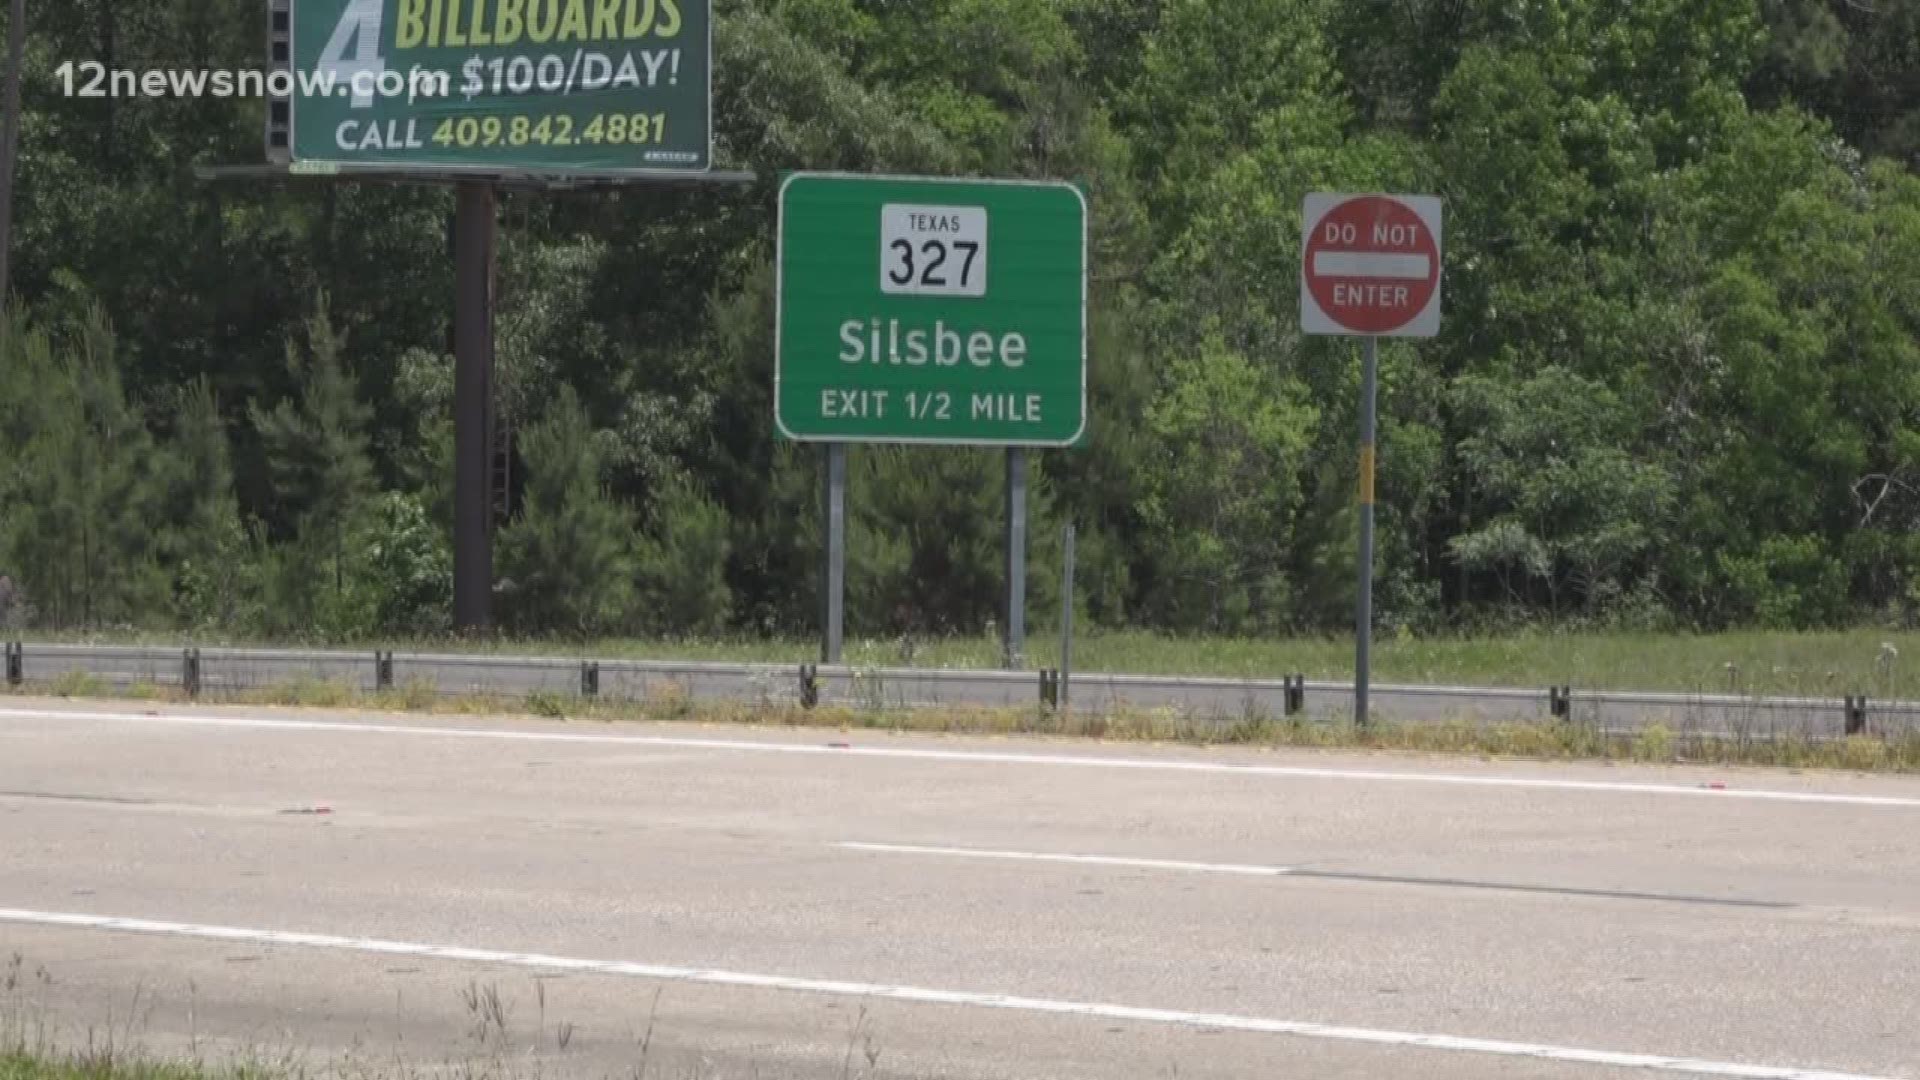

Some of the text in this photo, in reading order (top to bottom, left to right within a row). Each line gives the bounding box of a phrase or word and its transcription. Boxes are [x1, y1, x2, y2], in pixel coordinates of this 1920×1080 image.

[395, 0, 681, 48] BILLBOARDS
[316, 0, 386, 108] 4
[460, 48, 681, 102] $100/DAY!
[335, 113, 666, 150] CALL 409.842.4881
[909, 213, 960, 232] TEXAS
[1325, 222, 1418, 246] DO NOT
[888, 238, 979, 287] 327
[1333, 283, 1408, 307] ENTER
[838, 318, 1027, 367] Silsbee
[821, 389, 1042, 422] EXIT 1/2 MILE
